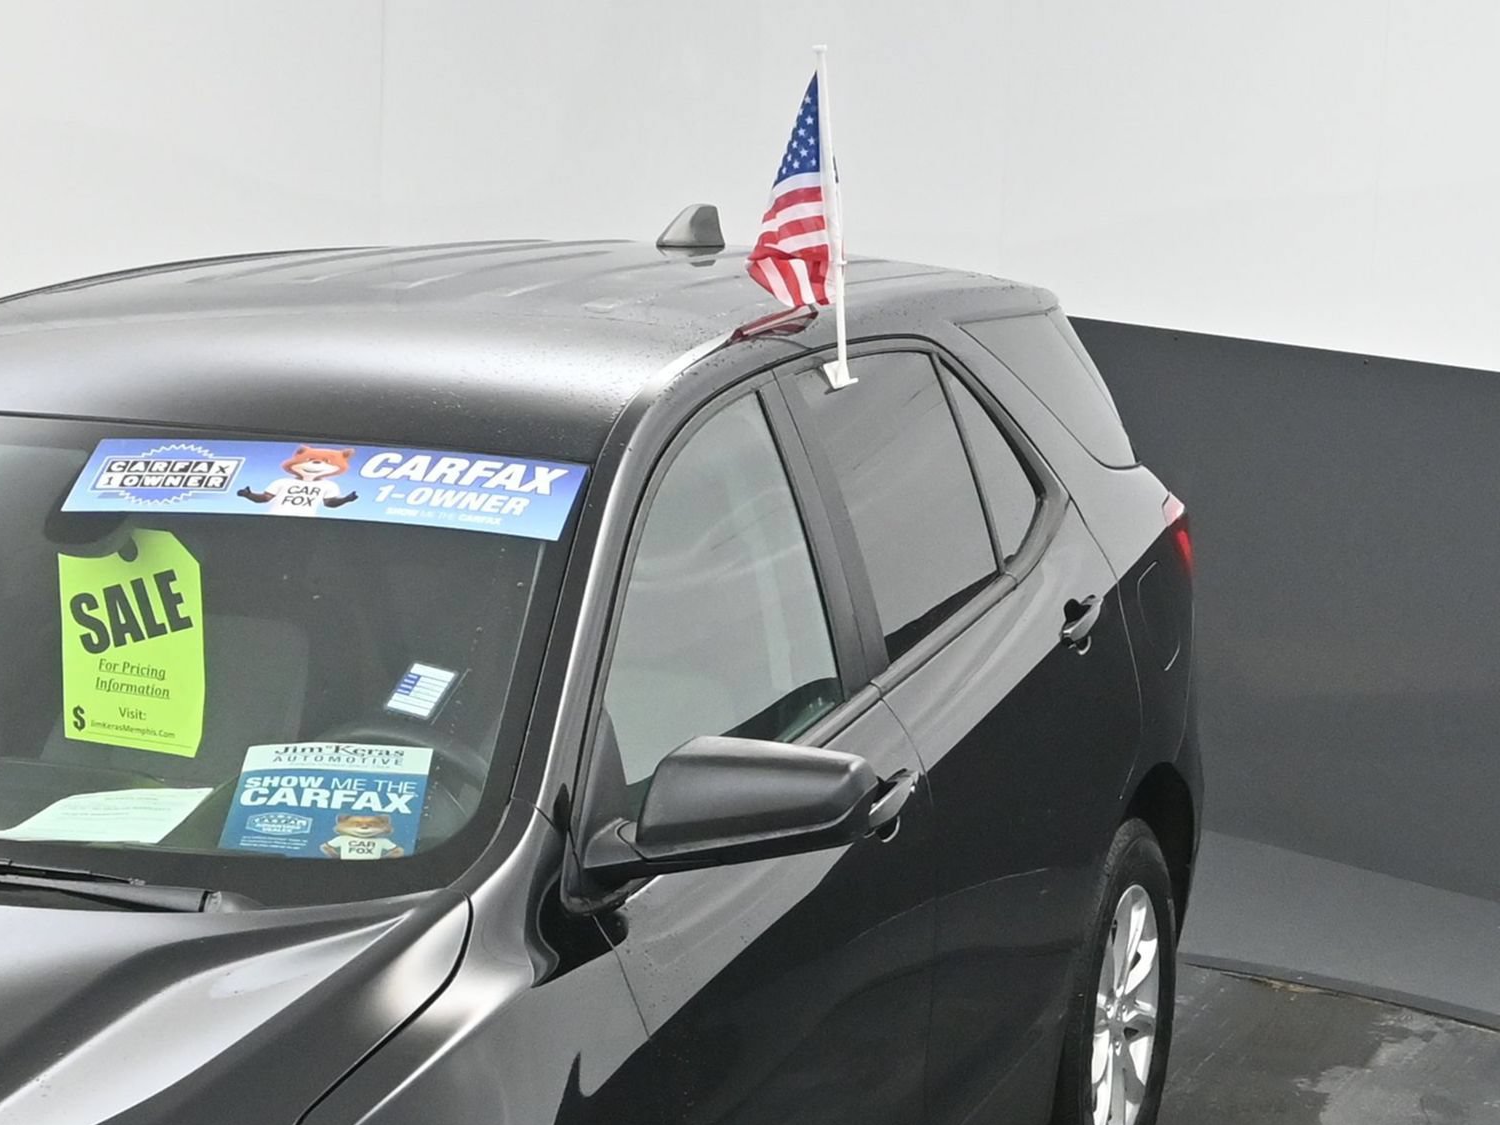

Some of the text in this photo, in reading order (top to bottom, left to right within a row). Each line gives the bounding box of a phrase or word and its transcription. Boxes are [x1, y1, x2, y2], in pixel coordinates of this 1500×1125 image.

[107, 460, 234, 475] CARFAX
[361, 453, 568, 495] CARFAX
[120, 474, 230, 489] OWNER
[286, 485, 322, 497] CAR
[280, 495, 315, 508] FOX
[374, 483, 531, 517] 1-OWNER
[69, 569, 194, 655] SALE
[99, 658, 167, 681] For Pricing
[94, 676, 170, 699] Information
[72, 704, 87, 732] $
[118, 705, 147, 721] Visit:
[272, 755, 405, 767] AUTOMOTIVE
[244, 776, 417, 793] SHOW ME THE
[240, 788, 413, 814] CARFAX
[347, 847, 375, 855] FOX
